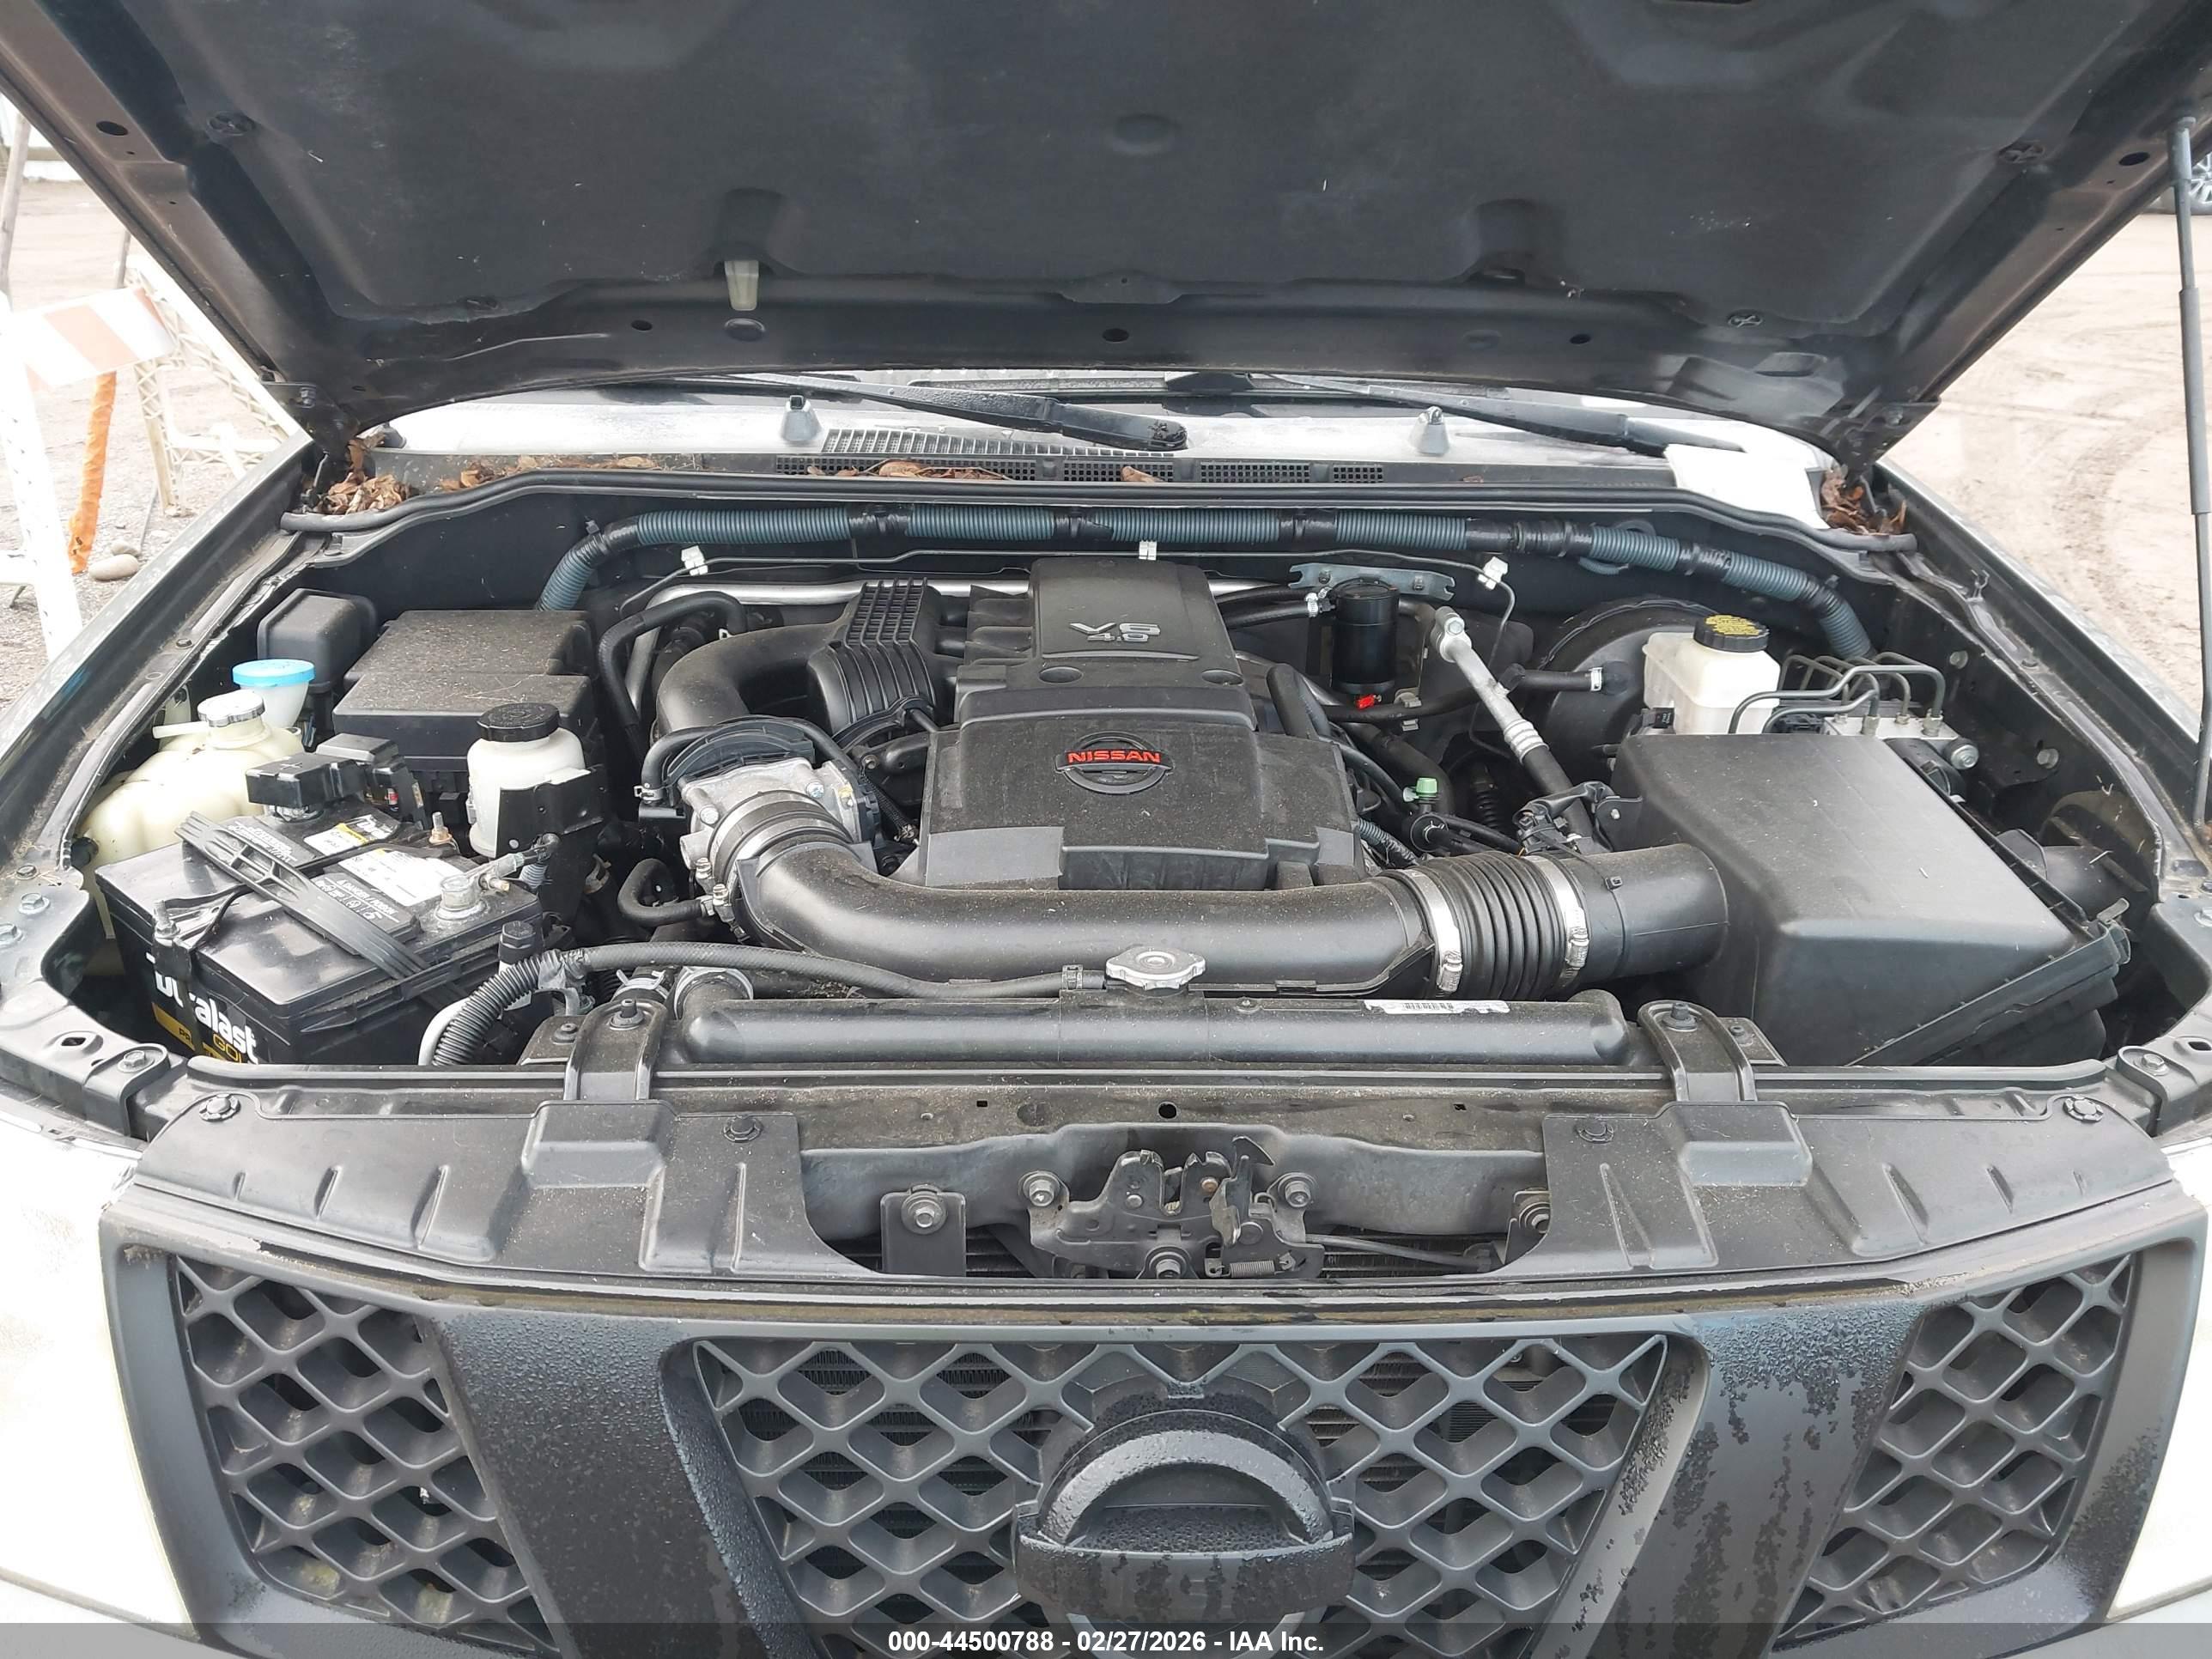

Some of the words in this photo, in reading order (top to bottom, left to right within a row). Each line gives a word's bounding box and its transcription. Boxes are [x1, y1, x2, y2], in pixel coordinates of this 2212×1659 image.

[1070, 623, 1161, 635] V6
[1087, 632, 1149, 642] 4.0
[1068, 750, 1161, 764] NISSAN
